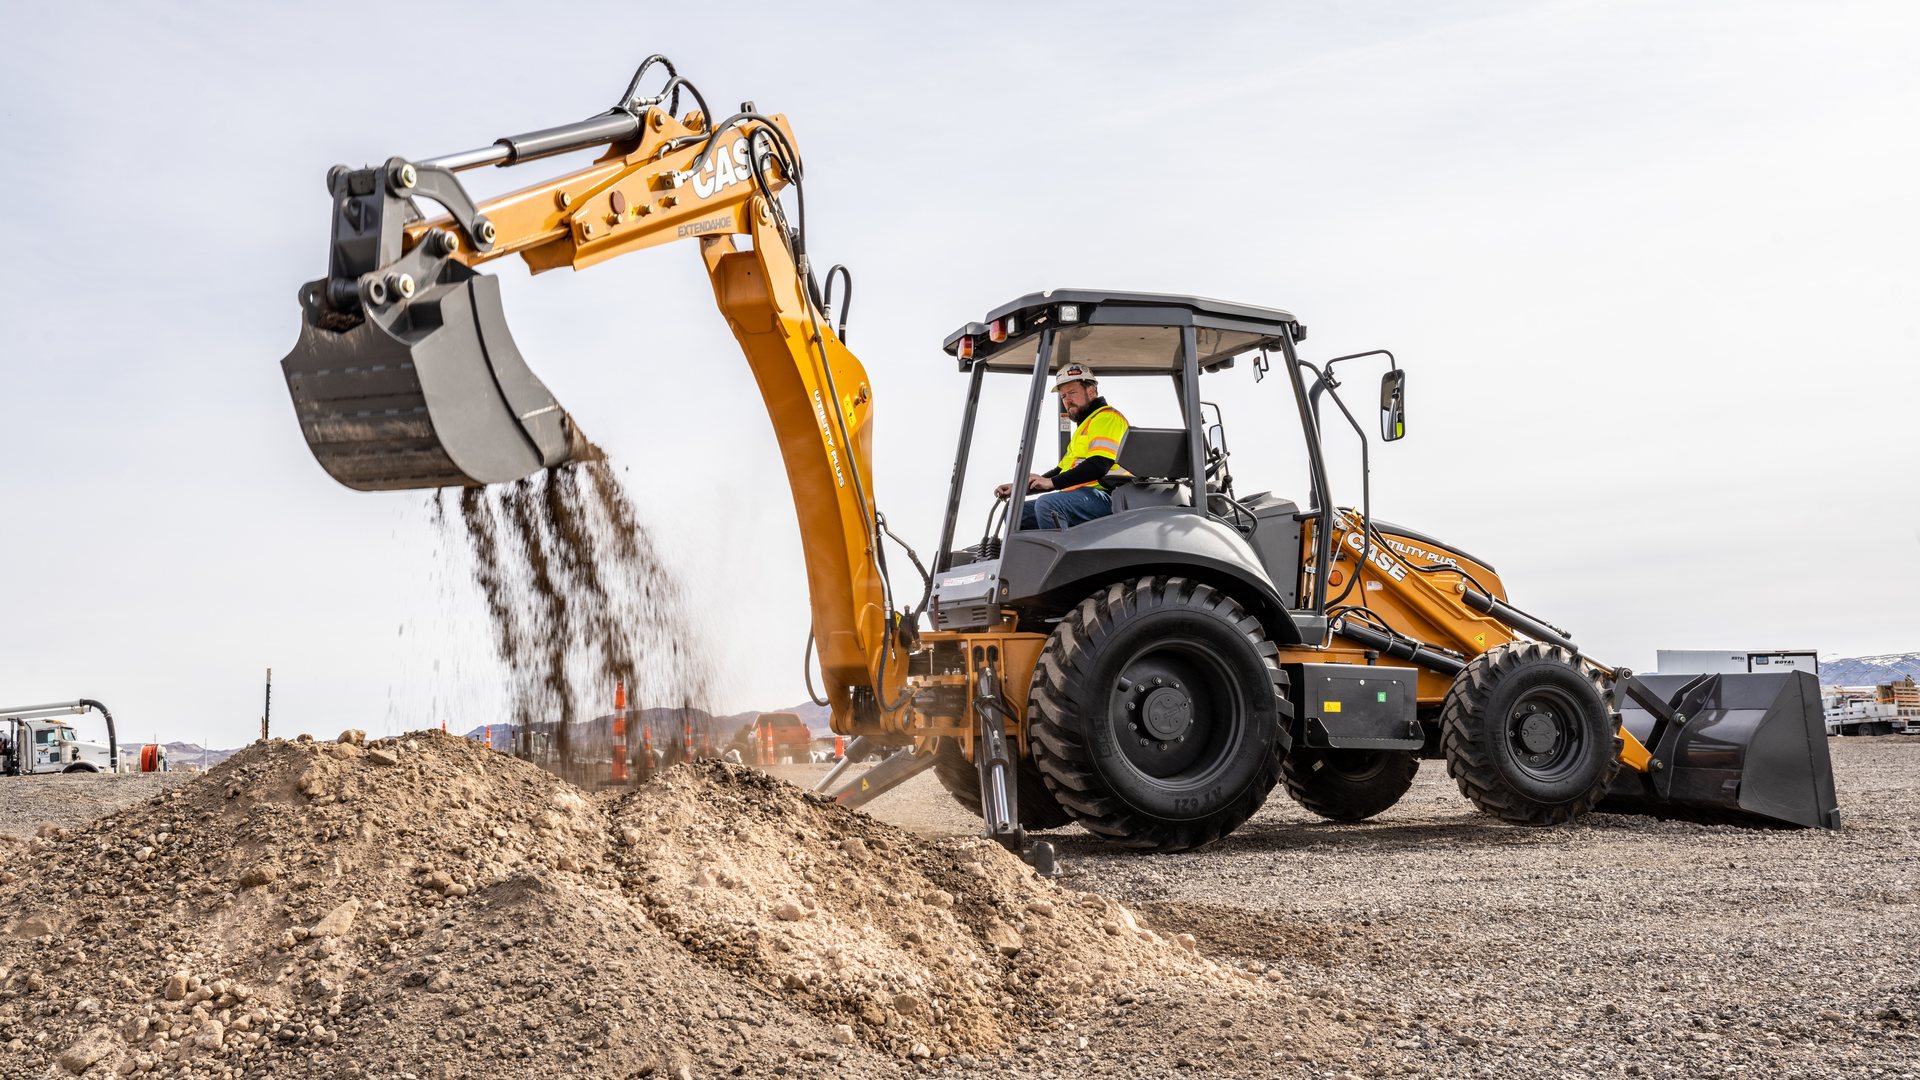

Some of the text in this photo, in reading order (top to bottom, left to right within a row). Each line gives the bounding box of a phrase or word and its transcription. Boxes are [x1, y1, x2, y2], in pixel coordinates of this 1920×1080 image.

[692, 131, 772, 199] CASE
[677, 216, 732, 238] EXTENDAHOE
[813, 389, 845, 488] UTILITY PLUS
[1346, 531, 1409, 582] CASE
[1425, 551, 1457, 565] PLUS
[1535, 669, 1556, 680] 567
[1092, 717, 1111, 758] BKT
[1174, 785, 1223, 812] AT 621
